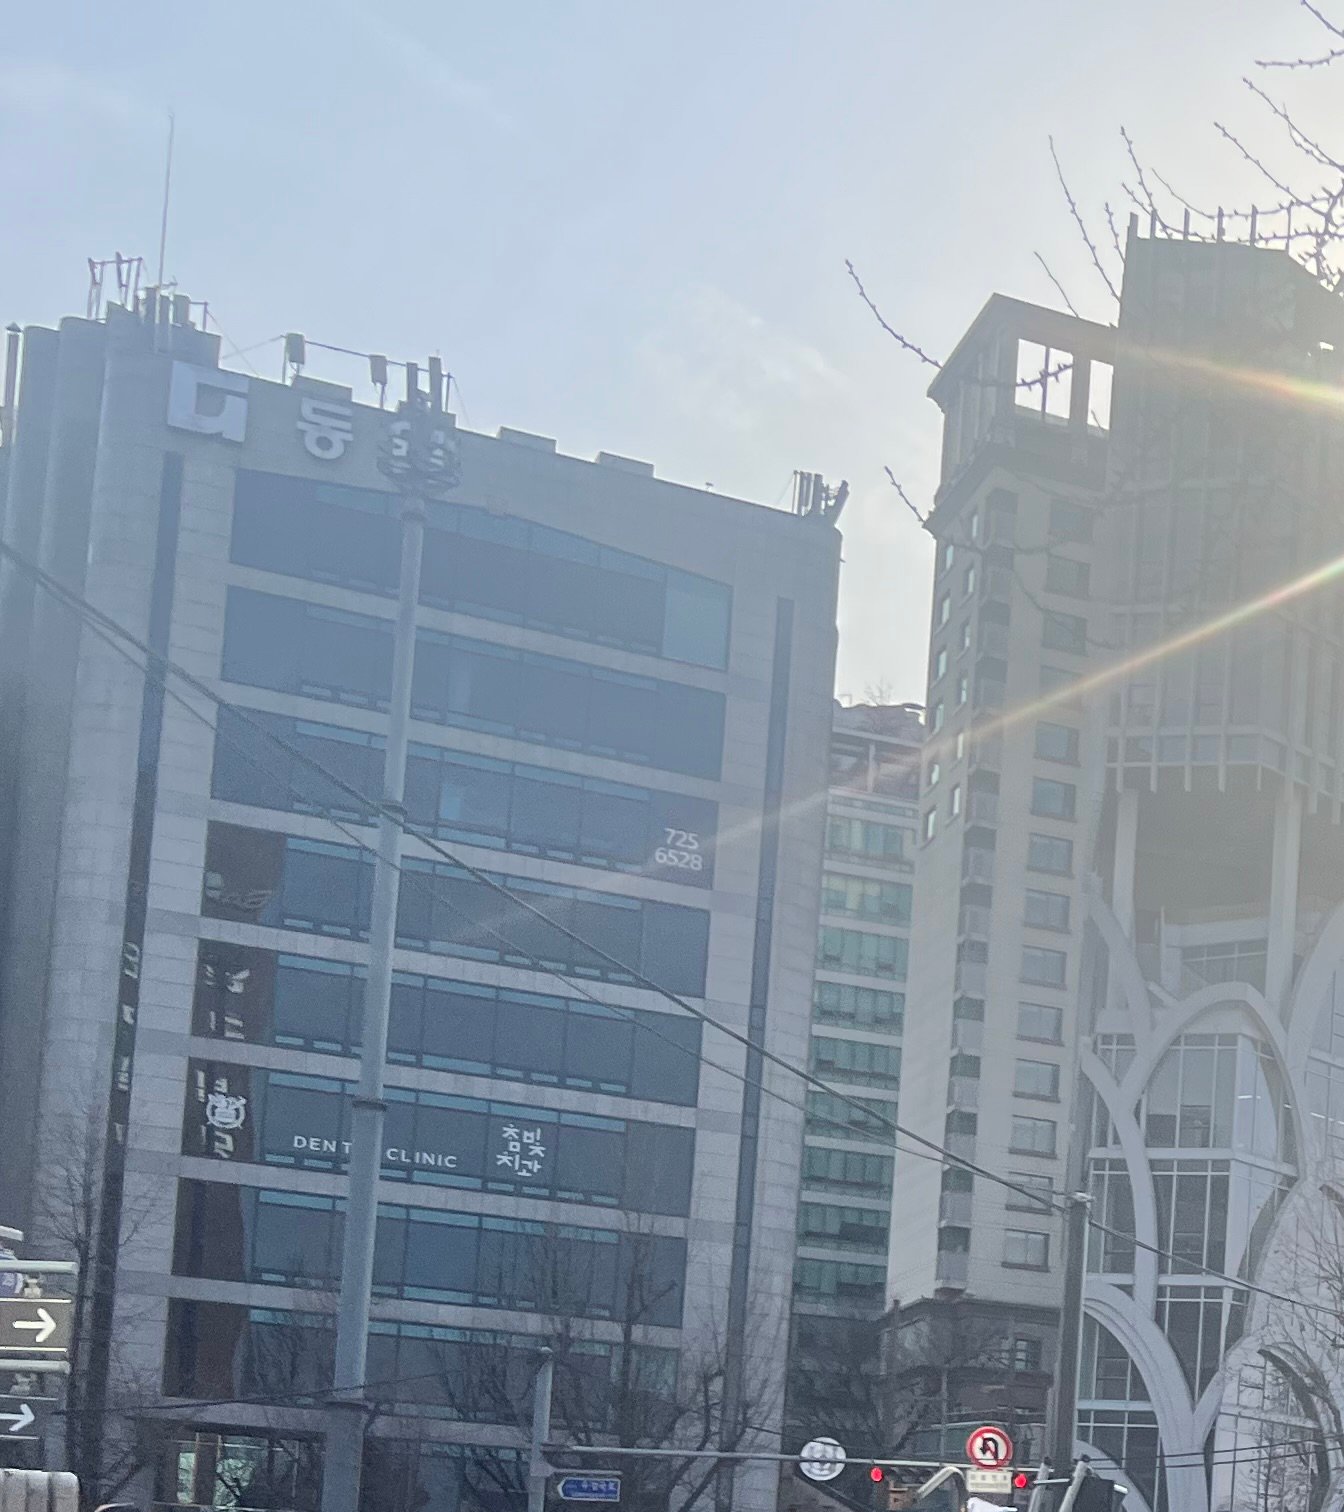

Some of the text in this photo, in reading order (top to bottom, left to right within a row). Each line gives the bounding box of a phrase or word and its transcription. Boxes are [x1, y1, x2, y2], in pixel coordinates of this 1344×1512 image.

[664, 827, 699, 849] 725
[655, 846, 703, 871] 6528
[293, 1135, 457, 1168] DENT CLINIC
[502, 1123, 546, 1157] 참빛
[496, 1151, 542, 1177] 치과
